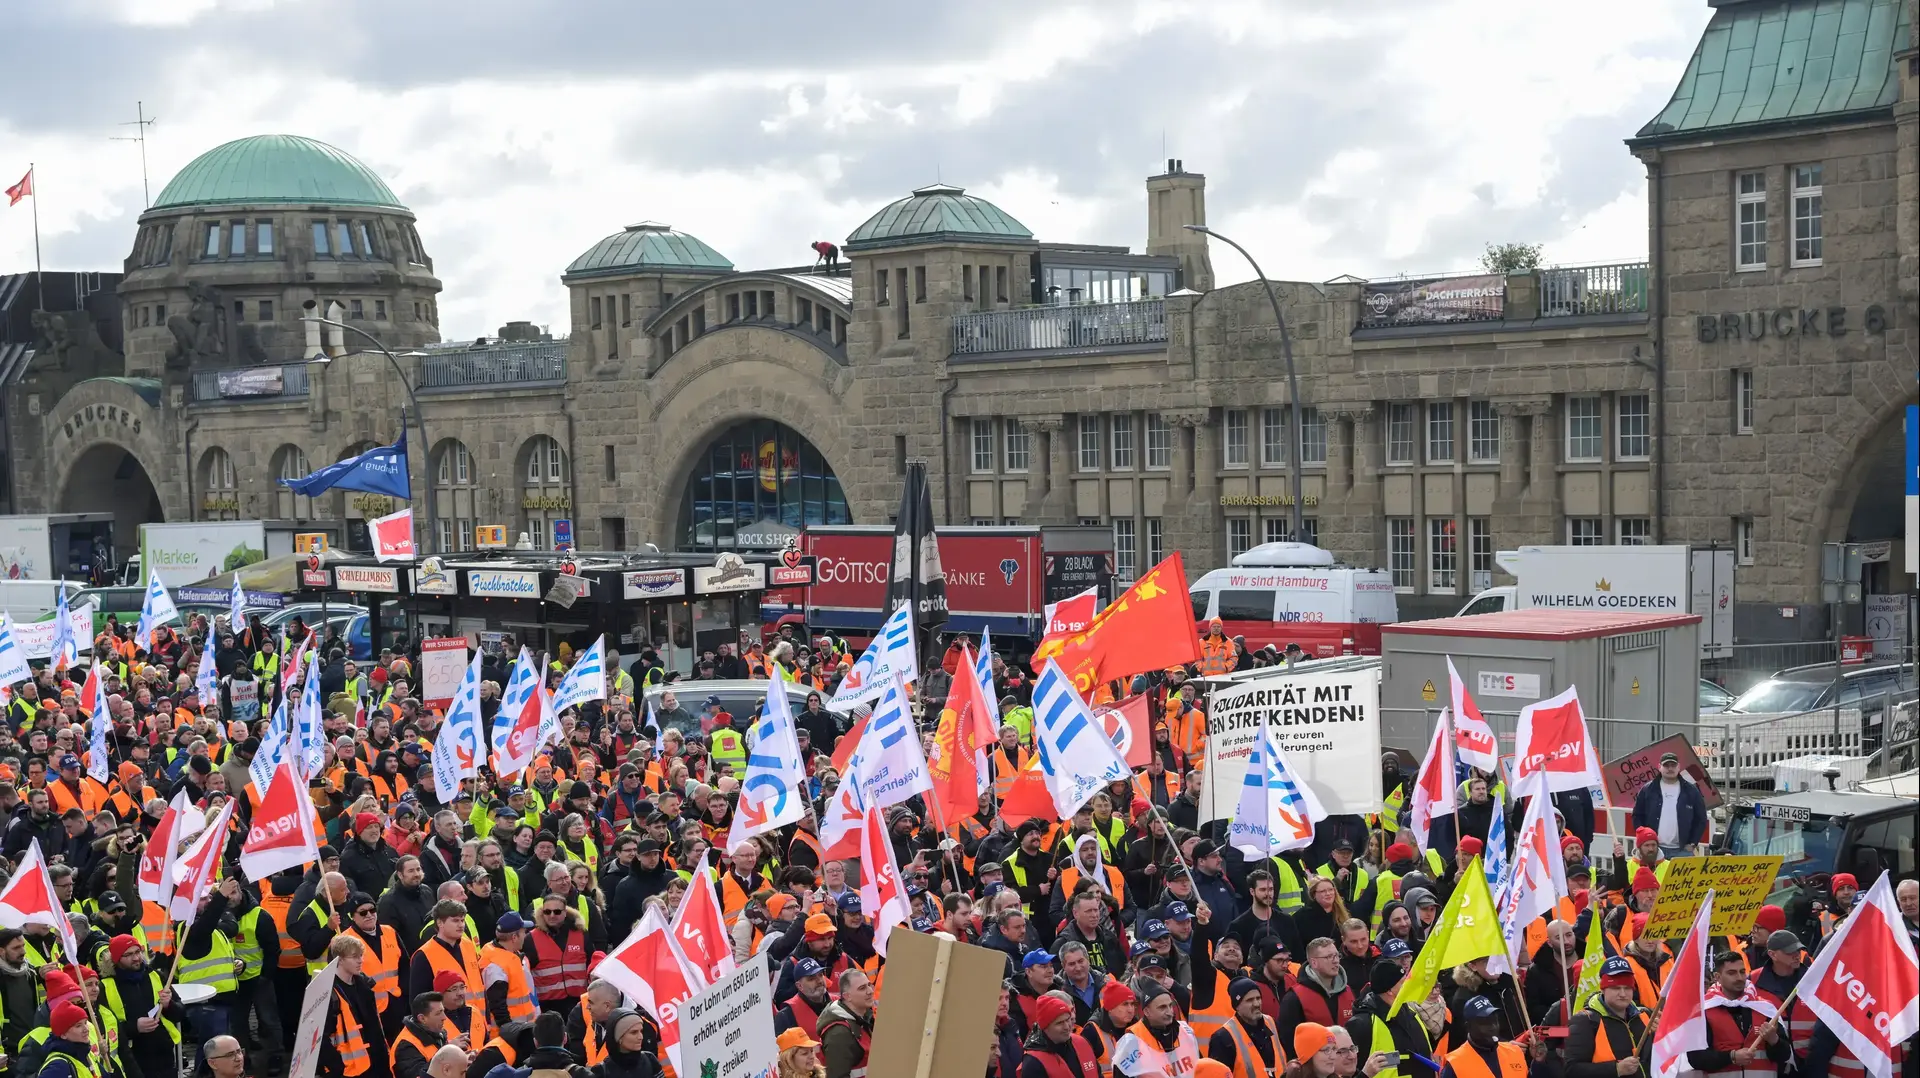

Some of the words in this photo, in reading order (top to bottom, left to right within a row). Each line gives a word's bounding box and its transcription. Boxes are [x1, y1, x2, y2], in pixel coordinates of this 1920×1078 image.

[1864, 305, 1886, 335] 6
[738, 533, 764, 545] ROCK
[1064, 557, 1074, 571] 28
[1074, 556, 1094, 570] BLACK
[337, 571, 392, 583] SCHNELLIMBISS
[471, 573, 535, 594] Fischbrötchen
[776, 570, 809, 581] ASTRA
[1230, 575, 1248, 587] Wir
[1251, 575, 1273, 587] sind
[1276, 575, 1329, 590] Hamburg
[178, 590, 230, 602] Hafenrundfahrt
[249, 595, 282, 606] Schwarz
[1531, 594, 1594, 607] WILHELM
[1597, 595, 1677, 608] GOEDEKEN
[1279, 611, 1300, 623] NDR
[428, 664, 464, 685] 650
[1480, 674, 1515, 691] TMS
[1313, 685, 1353, 703] MIT
[1228, 704, 1365, 731] STREKENDEN!
[1222, 737, 1234, 748] Wir
[1293, 731, 1325, 741] euren
[1620, 755, 1651, 775] Ohne
[1760, 805, 1773, 817] WT
[1777, 807, 1790, 819] AH
[1791, 808, 1810, 820] 485
[1671, 862, 1697, 878] Wir
[1750, 861, 1775, 876] gar
[1664, 878, 1693, 893] nicht
[1697, 878, 1713, 888] so
[1715, 872, 1769, 887] schlecht
[1714, 888, 1735, 899] wie
[1739, 886, 1760, 897] wir
[1651, 902, 1717, 925] bezaht
[1642, 927, 1670, 940] Nicht
[1608, 960, 1630, 970] EVG
[690, 1002, 703, 1021] Der
[704, 991, 721, 1012] Lohn
[721, 984, 733, 1000] um
[732, 973, 746, 993] 650
[745, 966, 760, 984] Euro
[693, 1018, 718, 1047] erhöht
[717, 1004, 743, 1029] werden
[742, 992, 762, 1013] sollte,
[724, 1027, 742, 1047] dann
[722, 1048, 749, 1077] streiken
[1119, 1049, 1143, 1071] EVG
[1162, 1055, 1194, 1078] WIR
